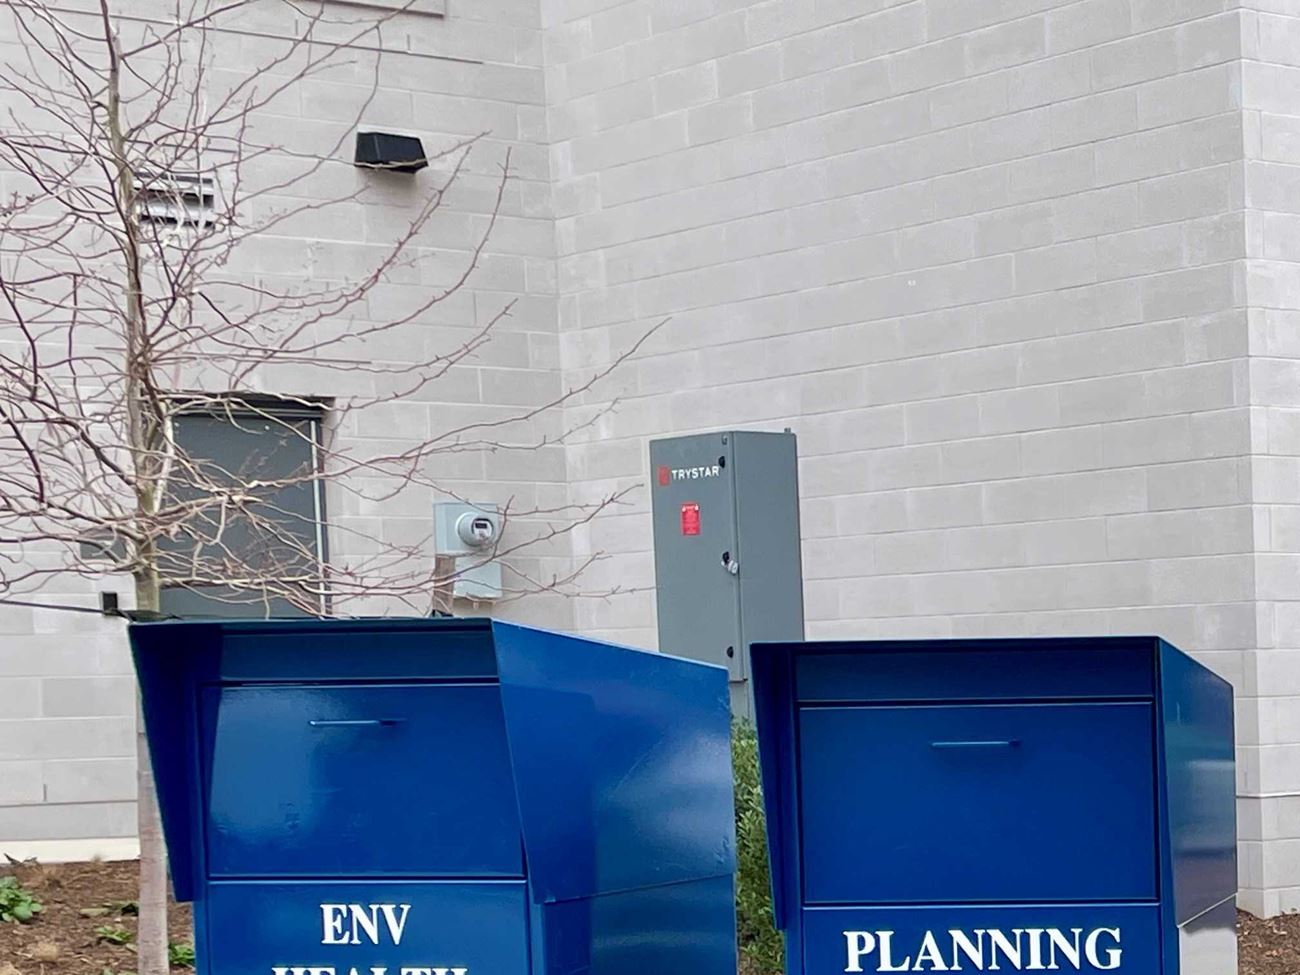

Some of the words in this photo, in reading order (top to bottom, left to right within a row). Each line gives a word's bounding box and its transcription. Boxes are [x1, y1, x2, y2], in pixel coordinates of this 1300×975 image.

[671, 465, 720, 480] TRYSTAR
[319, 904, 412, 945] ENV
[843, 927, 1123, 973] PLANNING
